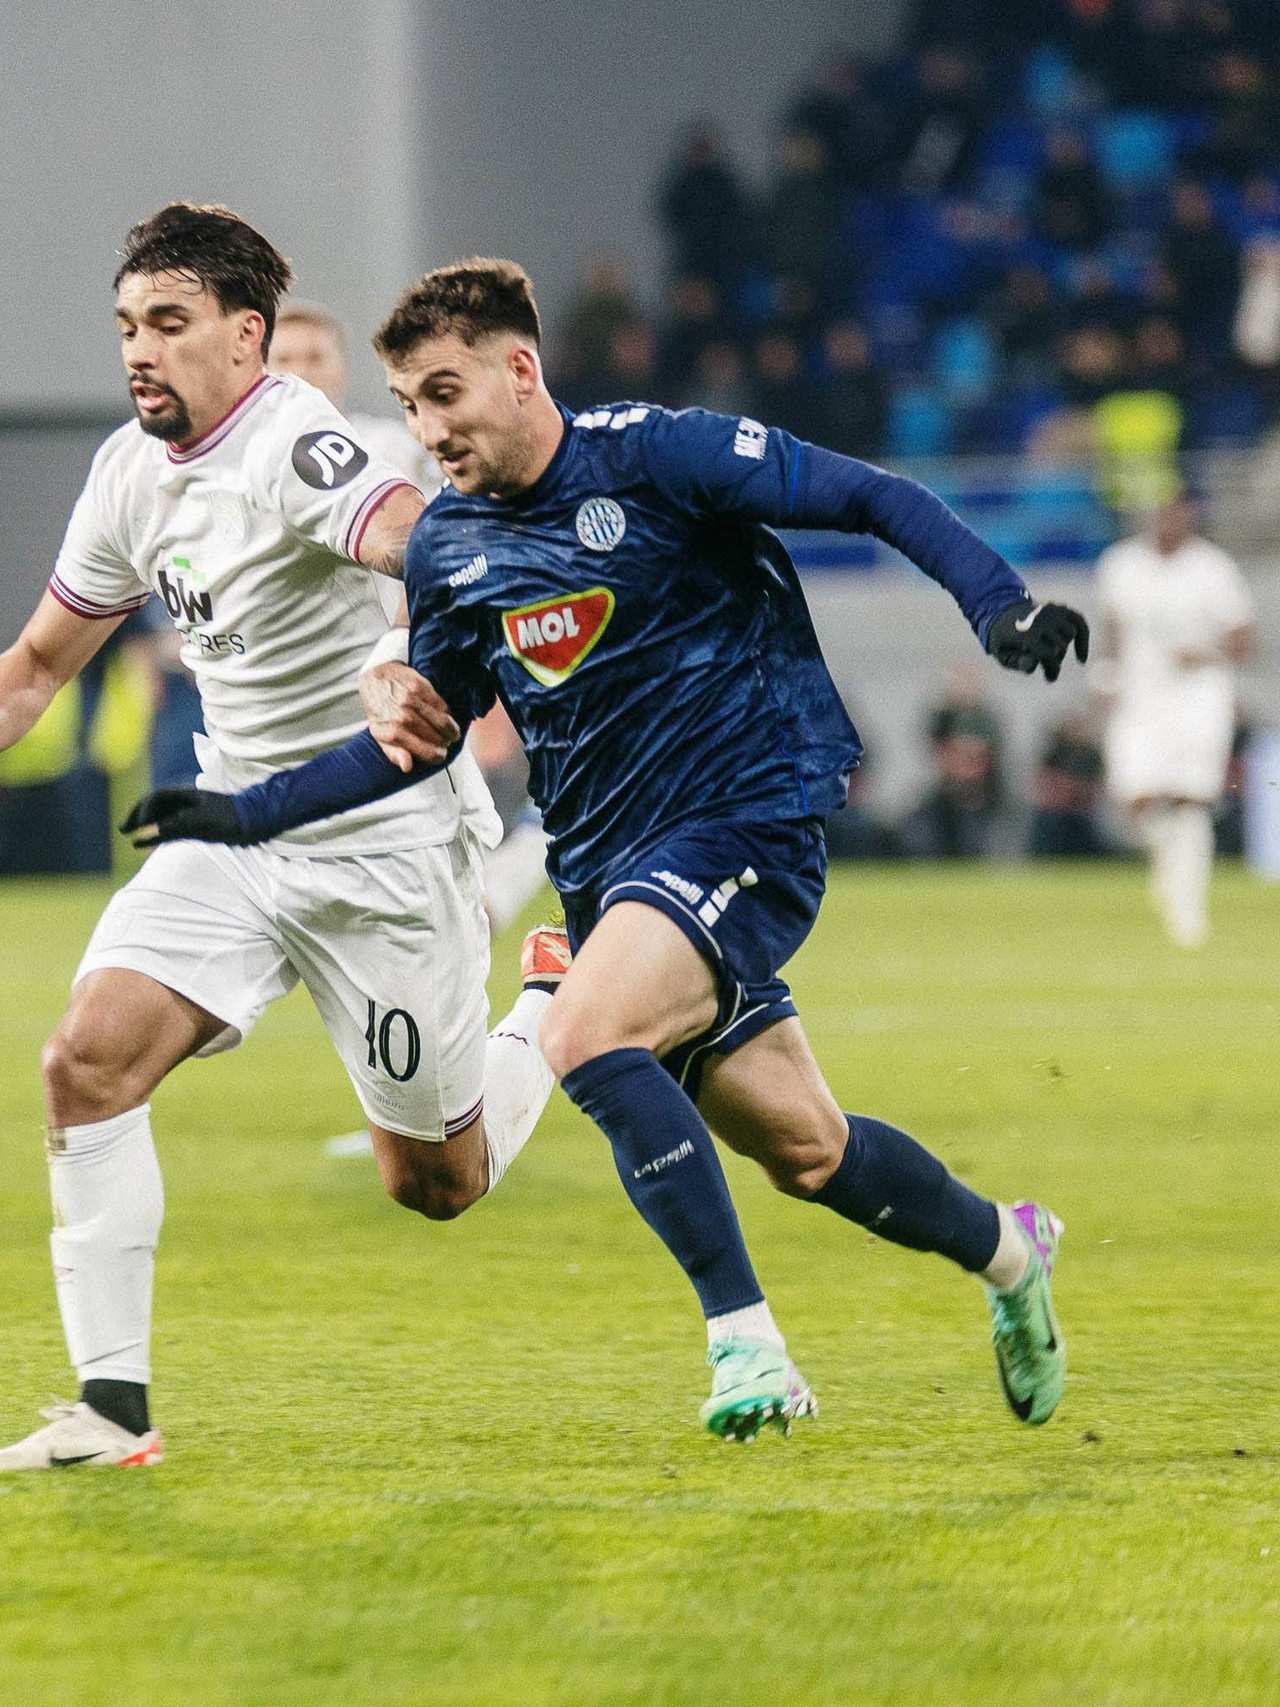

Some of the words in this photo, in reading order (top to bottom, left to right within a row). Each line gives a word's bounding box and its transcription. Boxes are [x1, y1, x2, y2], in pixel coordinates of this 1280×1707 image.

[307, 434, 355, 487] JD
[157, 570, 213, 622] bw
[184, 630, 246, 655] RES
[517, 606, 580, 649] MOL
[365, 998, 421, 1082] 10
